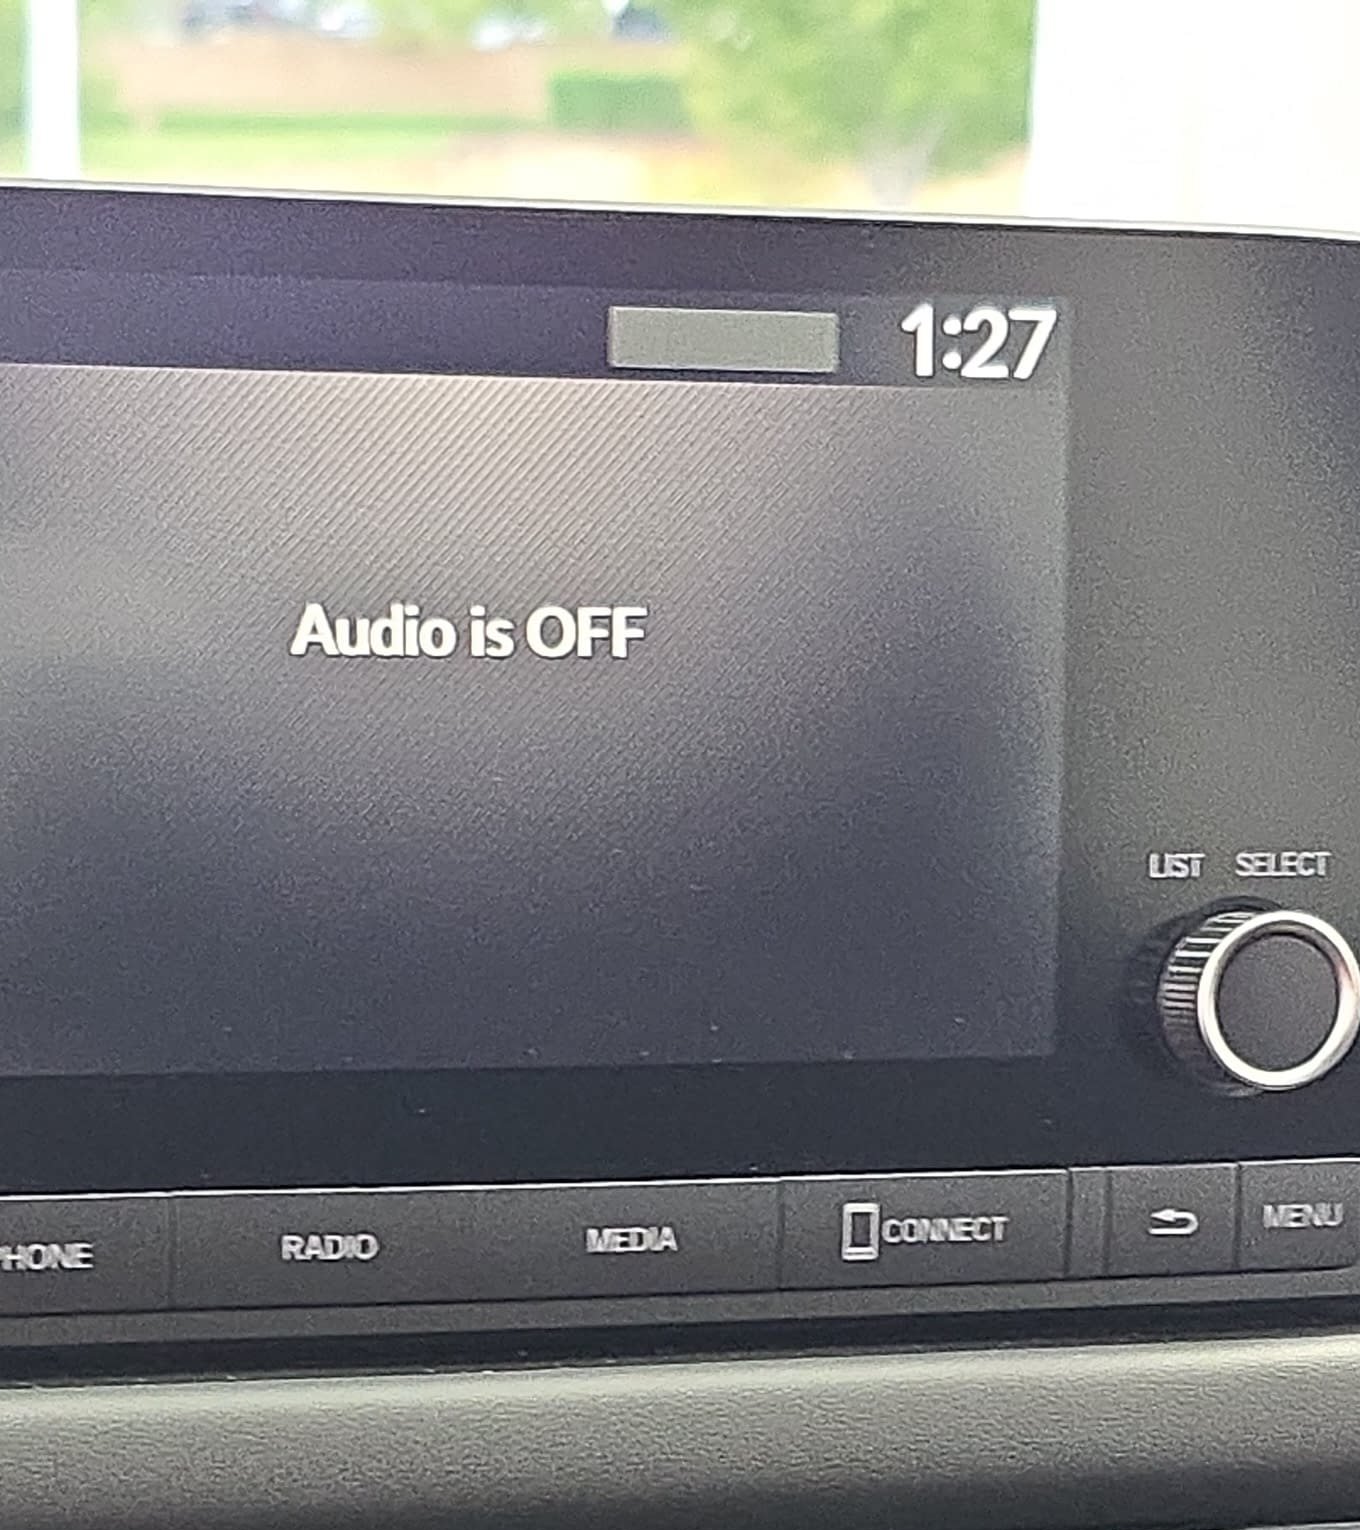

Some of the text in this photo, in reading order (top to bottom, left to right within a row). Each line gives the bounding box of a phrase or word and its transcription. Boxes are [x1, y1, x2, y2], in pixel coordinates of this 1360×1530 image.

[901, 303, 1057, 380] 1:27
[289, 602, 648, 658] Audio is OFF
[1148, 851, 1333, 878] LIST SELECT
[1262, 1201, 1343, 1229] MENU
[585, 1226, 679, 1254] MEDIA
[881, 1215, 1010, 1244] CONNECT
[281, 1233, 380, 1261] RADIO
